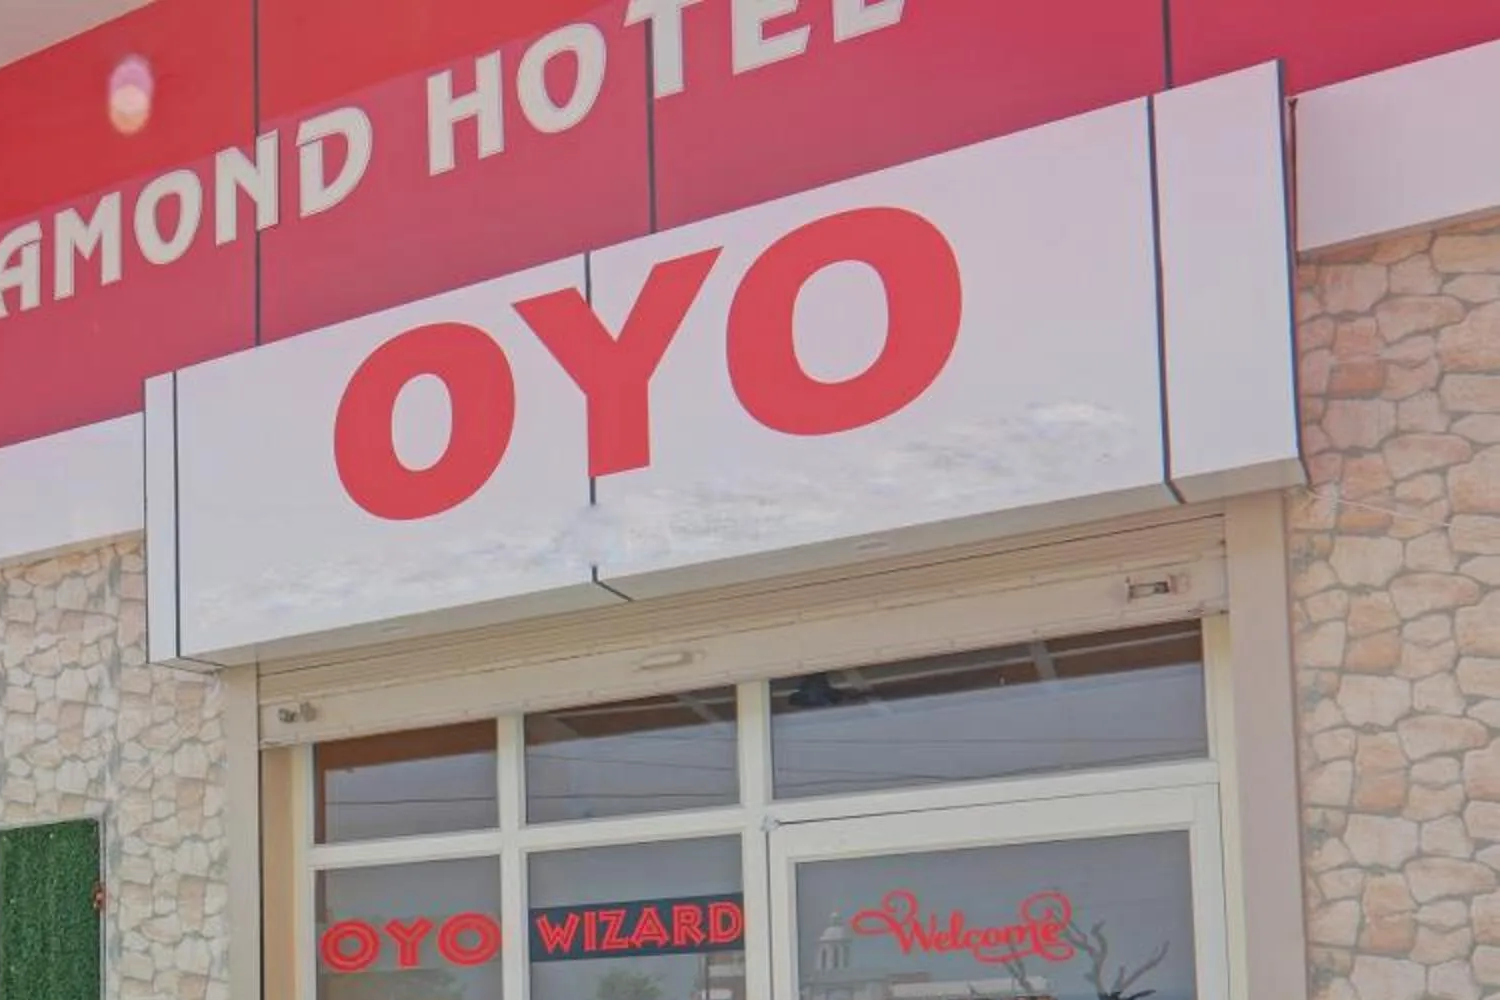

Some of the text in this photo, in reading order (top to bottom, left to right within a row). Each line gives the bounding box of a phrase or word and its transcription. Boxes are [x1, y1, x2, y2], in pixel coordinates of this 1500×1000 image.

[333, 206, 962, 520] OYO
[320, 901, 743, 972] OYO WIZARD
[851, 889, 1075, 963] Welcome
